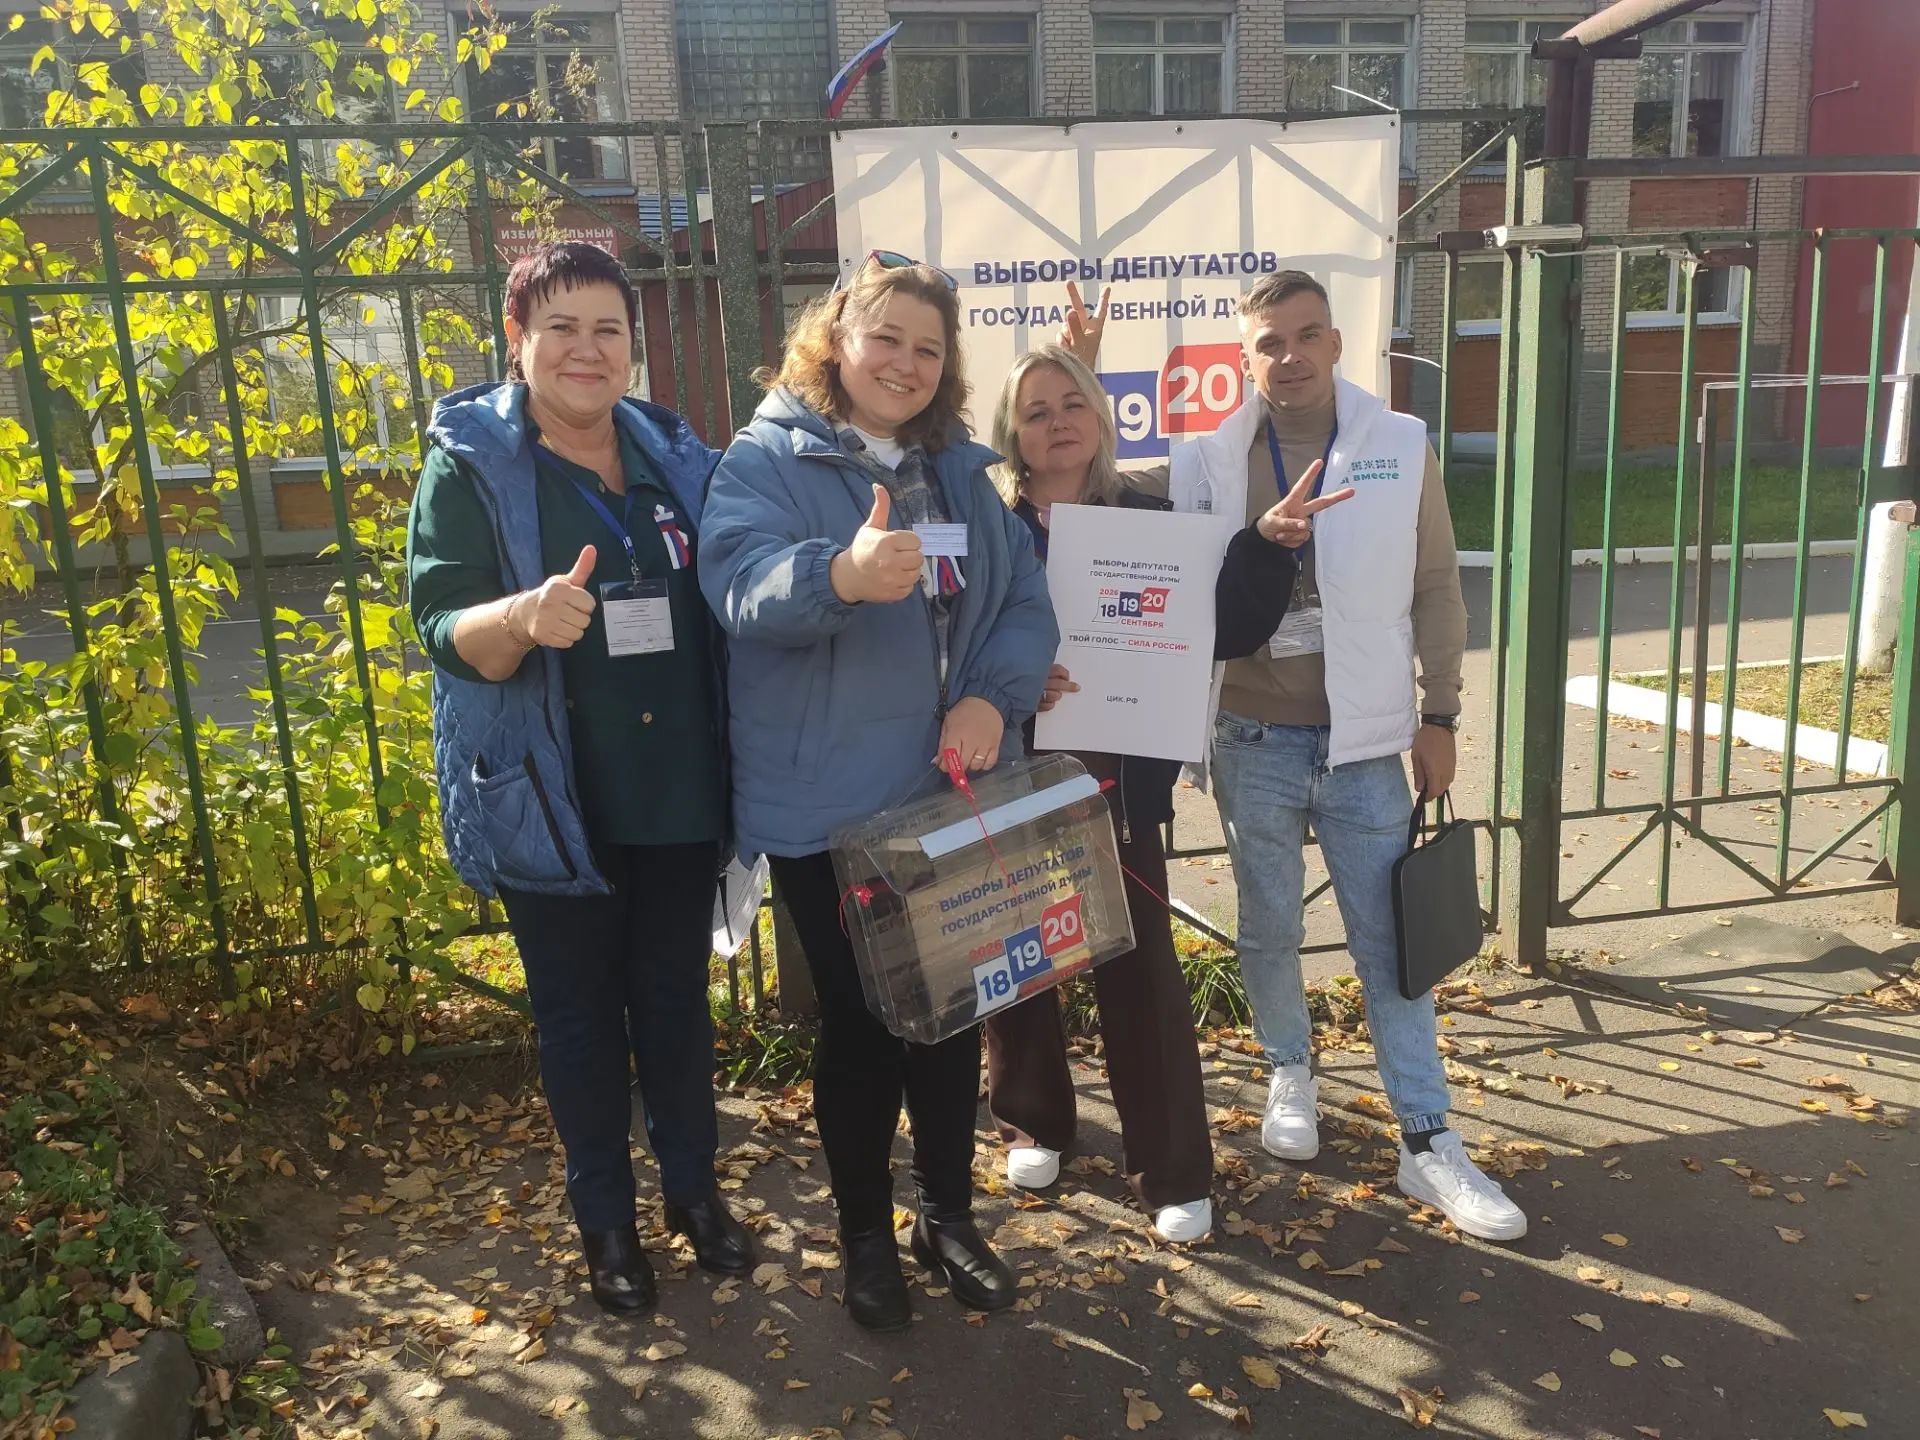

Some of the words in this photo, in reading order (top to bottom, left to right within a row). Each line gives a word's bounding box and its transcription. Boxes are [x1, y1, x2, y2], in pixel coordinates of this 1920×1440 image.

[500, 227, 614, 240] ИЗБИЛЬНЫЙ
[974, 257, 1102, 285] ВЫБОРЫ
[1110, 251, 1278, 283] ДЕПУТАТОВ
[1167, 363, 1239, 414] 20
[1089, 570, 1157, 581] ГОСУДАРСТВЕННОЙ
[1092, 559, 1129, 568] ВЫБОРЫ
[1130, 562, 1180, 572] ДЕПУТАТОВ
[1100, 604, 1117, 617] 18
[1121, 598, 1139, 612] 19
[1142, 593, 1164, 607] 20
[1120, 619, 1164, 629] СЕНТЯБРЯ
[1069, 634, 1090, 642] ТВОЙ
[1091, 636, 1118, 645] ГОЛОС
[1128, 640, 1150, 648] СИЛА
[1152, 642, 1190, 651] РОССИИ!
[1106, 695, 1138, 704] ЦИК.РФ
[940, 878, 1003, 913] ВЫБОРЫ
[1007, 845, 1085, 889] ДЕПУТАТОВ
[942, 880, 1056, 936] ГОСУДАРСТВЕННОЙ
[1058, 866, 1092, 888] ДУМЫ
[980, 969, 1011, 1001] 18
[1011, 940, 1042, 972] 19
[1043, 909, 1078, 945] 20
